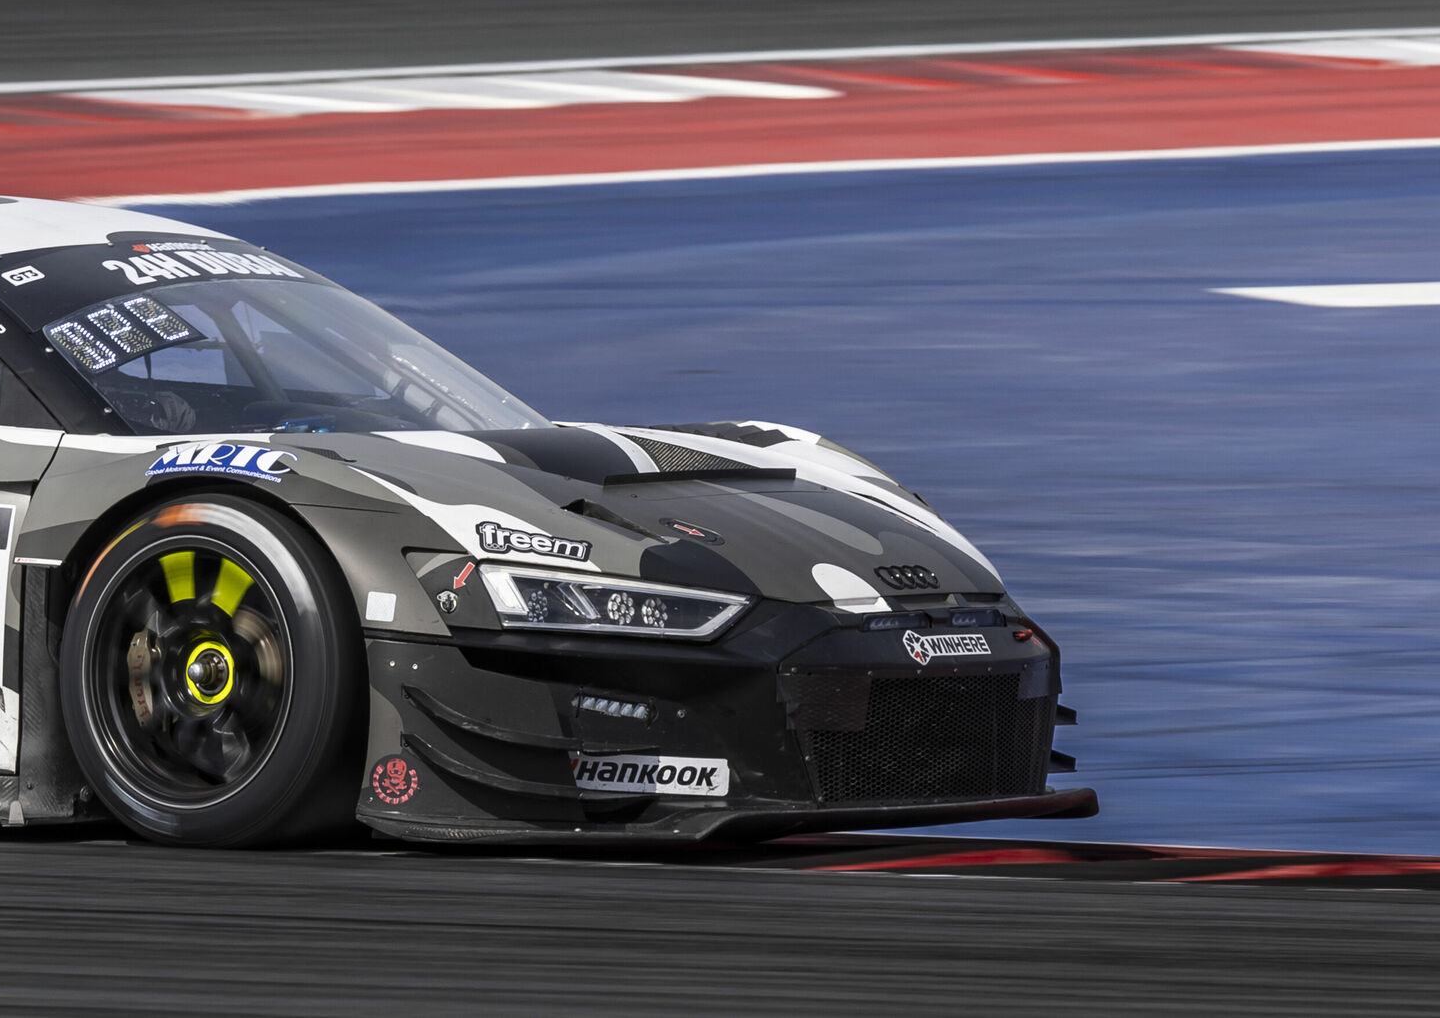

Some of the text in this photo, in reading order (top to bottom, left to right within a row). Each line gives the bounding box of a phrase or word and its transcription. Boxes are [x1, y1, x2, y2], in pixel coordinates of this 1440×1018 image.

[102, 253, 201, 285] 24H
[482, 523, 589, 559] freem
[926, 636, 990, 654] WINHERE
